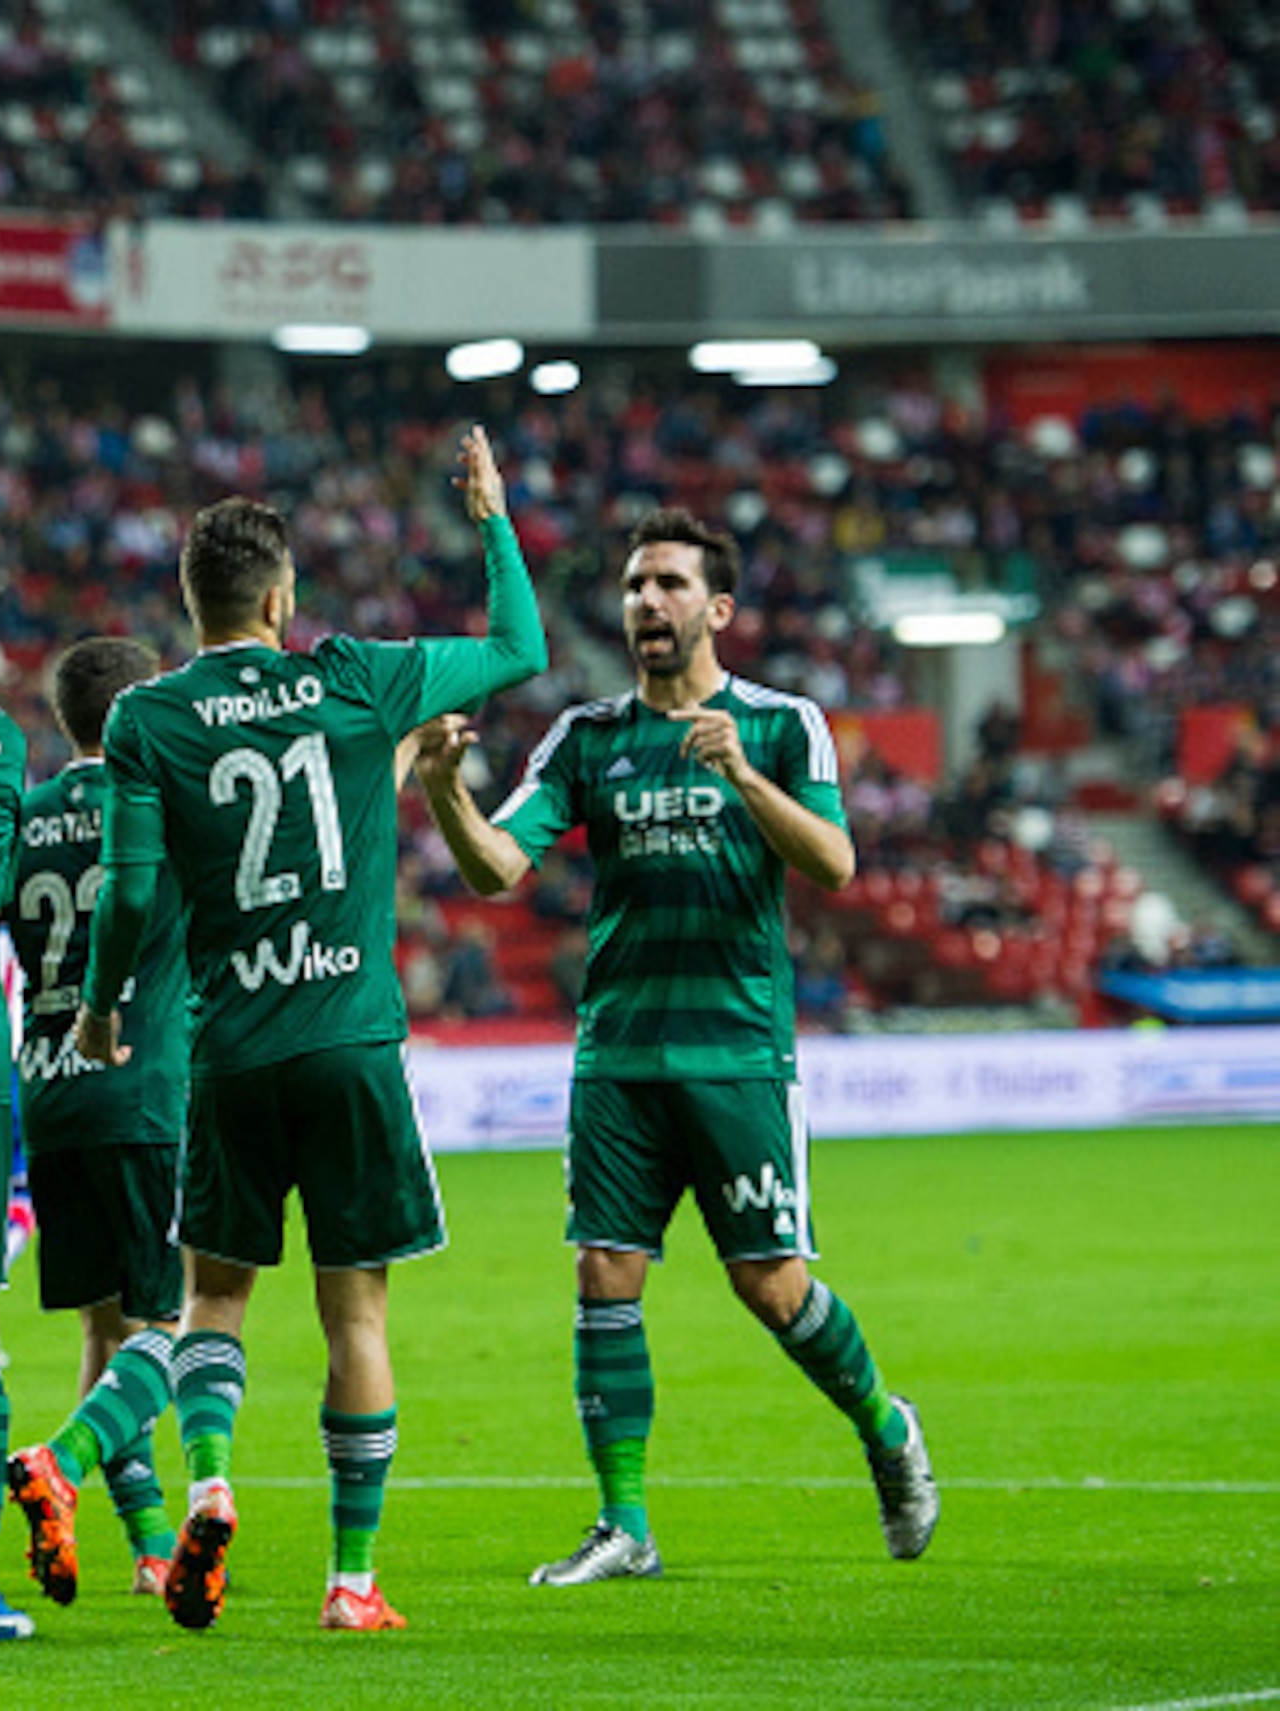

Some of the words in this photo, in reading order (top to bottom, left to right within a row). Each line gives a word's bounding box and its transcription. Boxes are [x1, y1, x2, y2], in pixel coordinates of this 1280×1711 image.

[208, 731, 347, 912] 21
[614, 785, 725, 822] UED
[230, 919, 361, 994] Wiko
[20, 1030, 107, 1083] Wik
